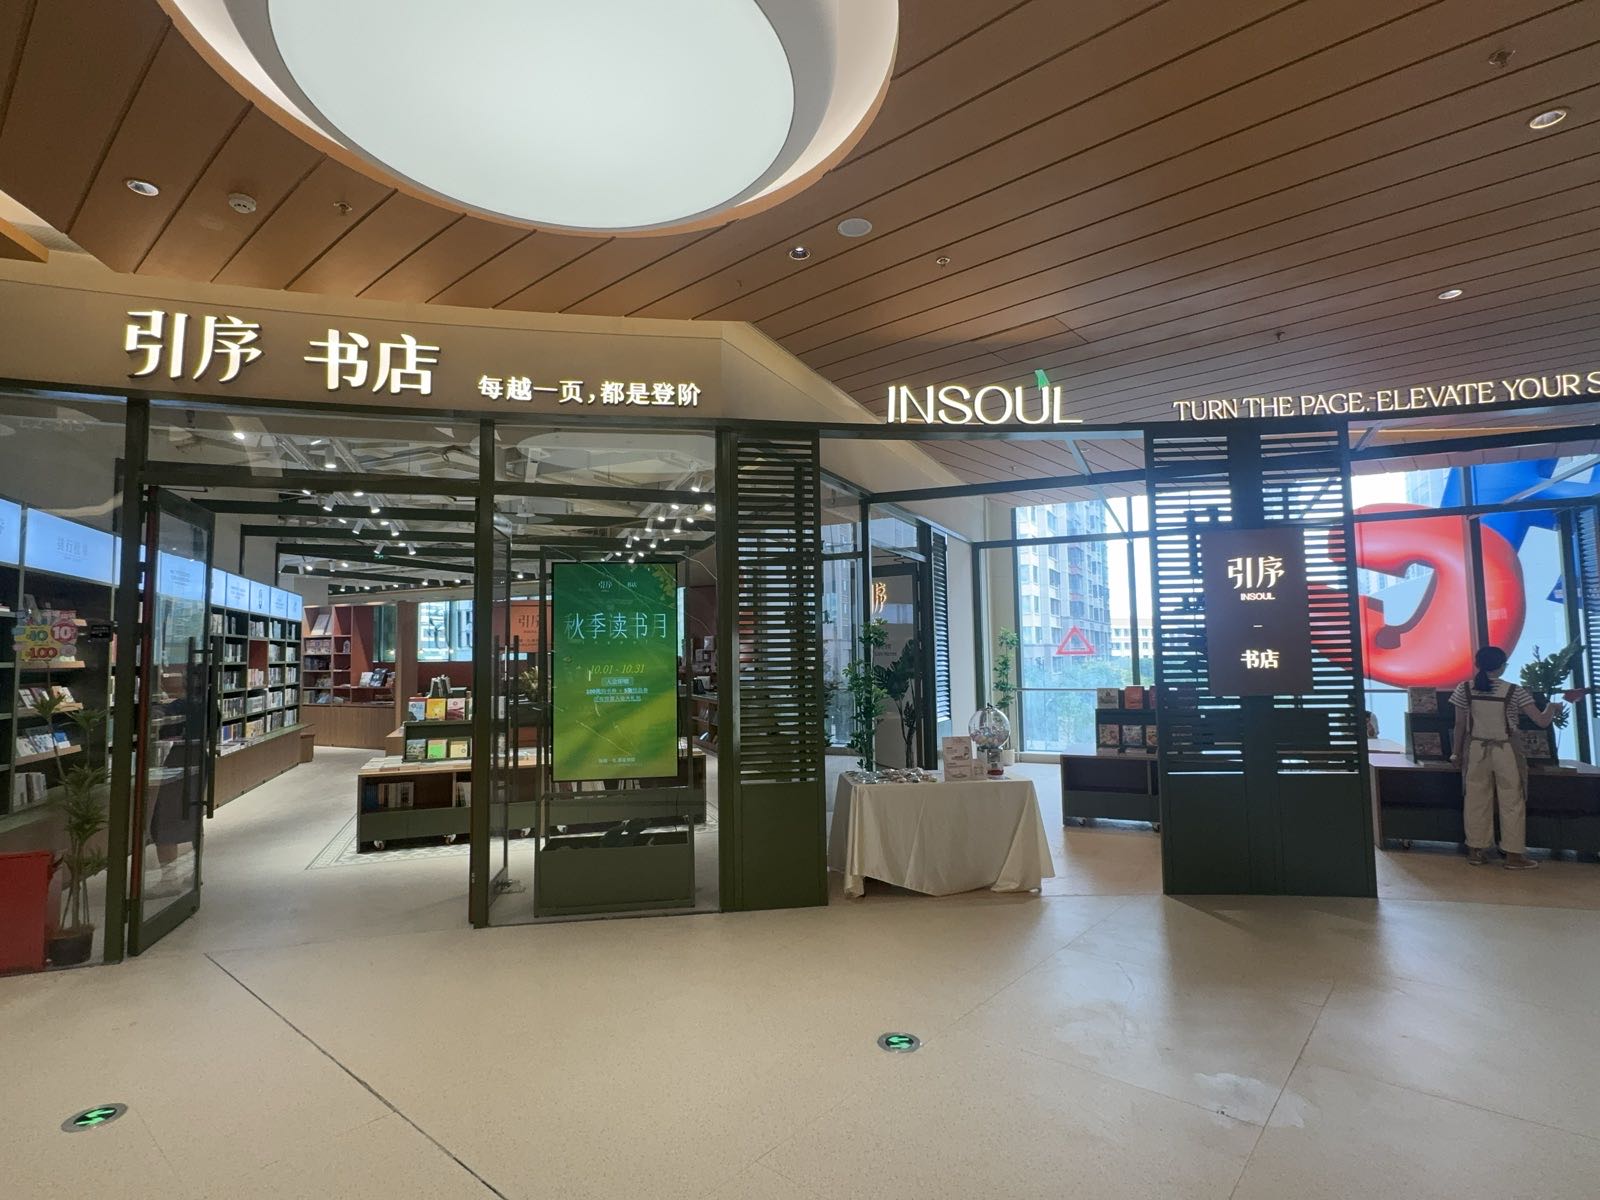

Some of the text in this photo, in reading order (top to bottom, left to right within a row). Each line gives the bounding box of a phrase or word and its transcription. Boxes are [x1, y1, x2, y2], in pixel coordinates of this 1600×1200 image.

[124, 310, 442, 396] 引序 书店
[887, 385, 1084, 425] INSOUL
[1172, 398, 1237, 422] TURN
[1243, 396, 1294, 418] THE
[1376, 381, 1495, 412] ELEVATE
[1501, 373, 1581, 401] YOUR
[1227, 555, 1286, 589] 引序
[1240, 592, 1276, 601] INSOUL
[564, 612, 667, 640] 秋季读书月
[1240, 649, 1280, 669] 书店
